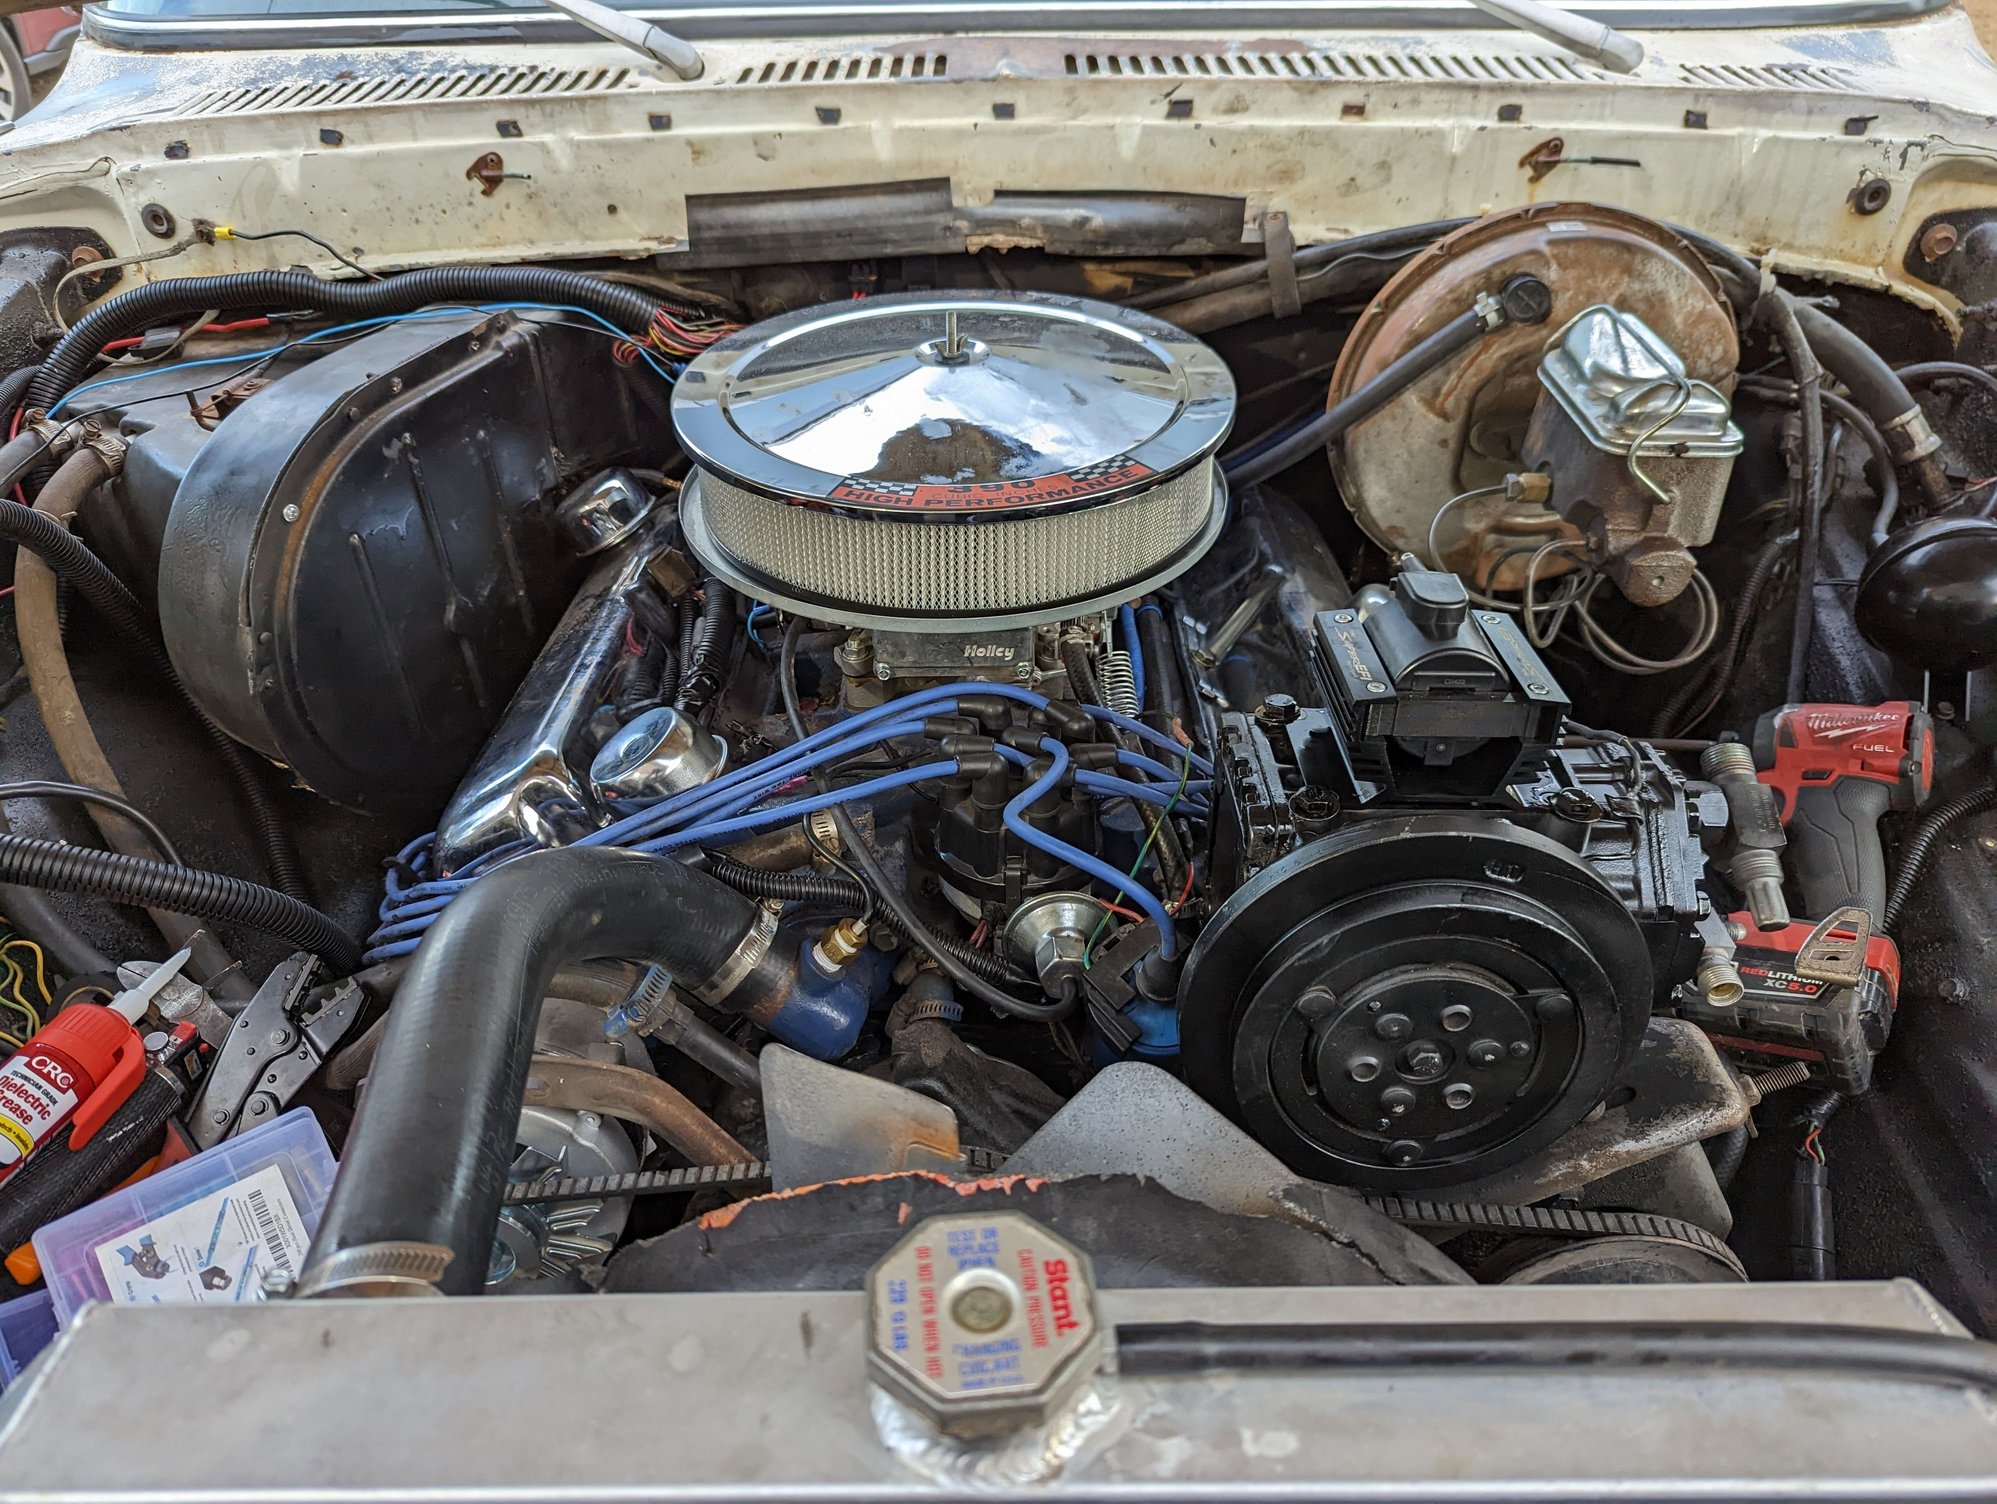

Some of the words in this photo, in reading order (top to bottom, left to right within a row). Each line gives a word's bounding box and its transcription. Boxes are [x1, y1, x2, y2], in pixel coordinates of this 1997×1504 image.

[843, 489, 914, 506] HIGH
[924, 469, 1140, 507] PERFORMANCE
[963, 643, 1015, 661] Holley
[1852, 743, 1895, 753] FUEL
[1764, 978, 1818, 994] XC5.0
[11, 1070, 42, 1092] TECHNICIAN
[41, 1088, 59, 1107] GRADE
[31, 1055, 74, 1089] CRC
[0, 1075, 51, 1121] Dielectric
[1044, 1259, 1081, 1337] Stant
[923, 1320, 940, 1352] WHEN
